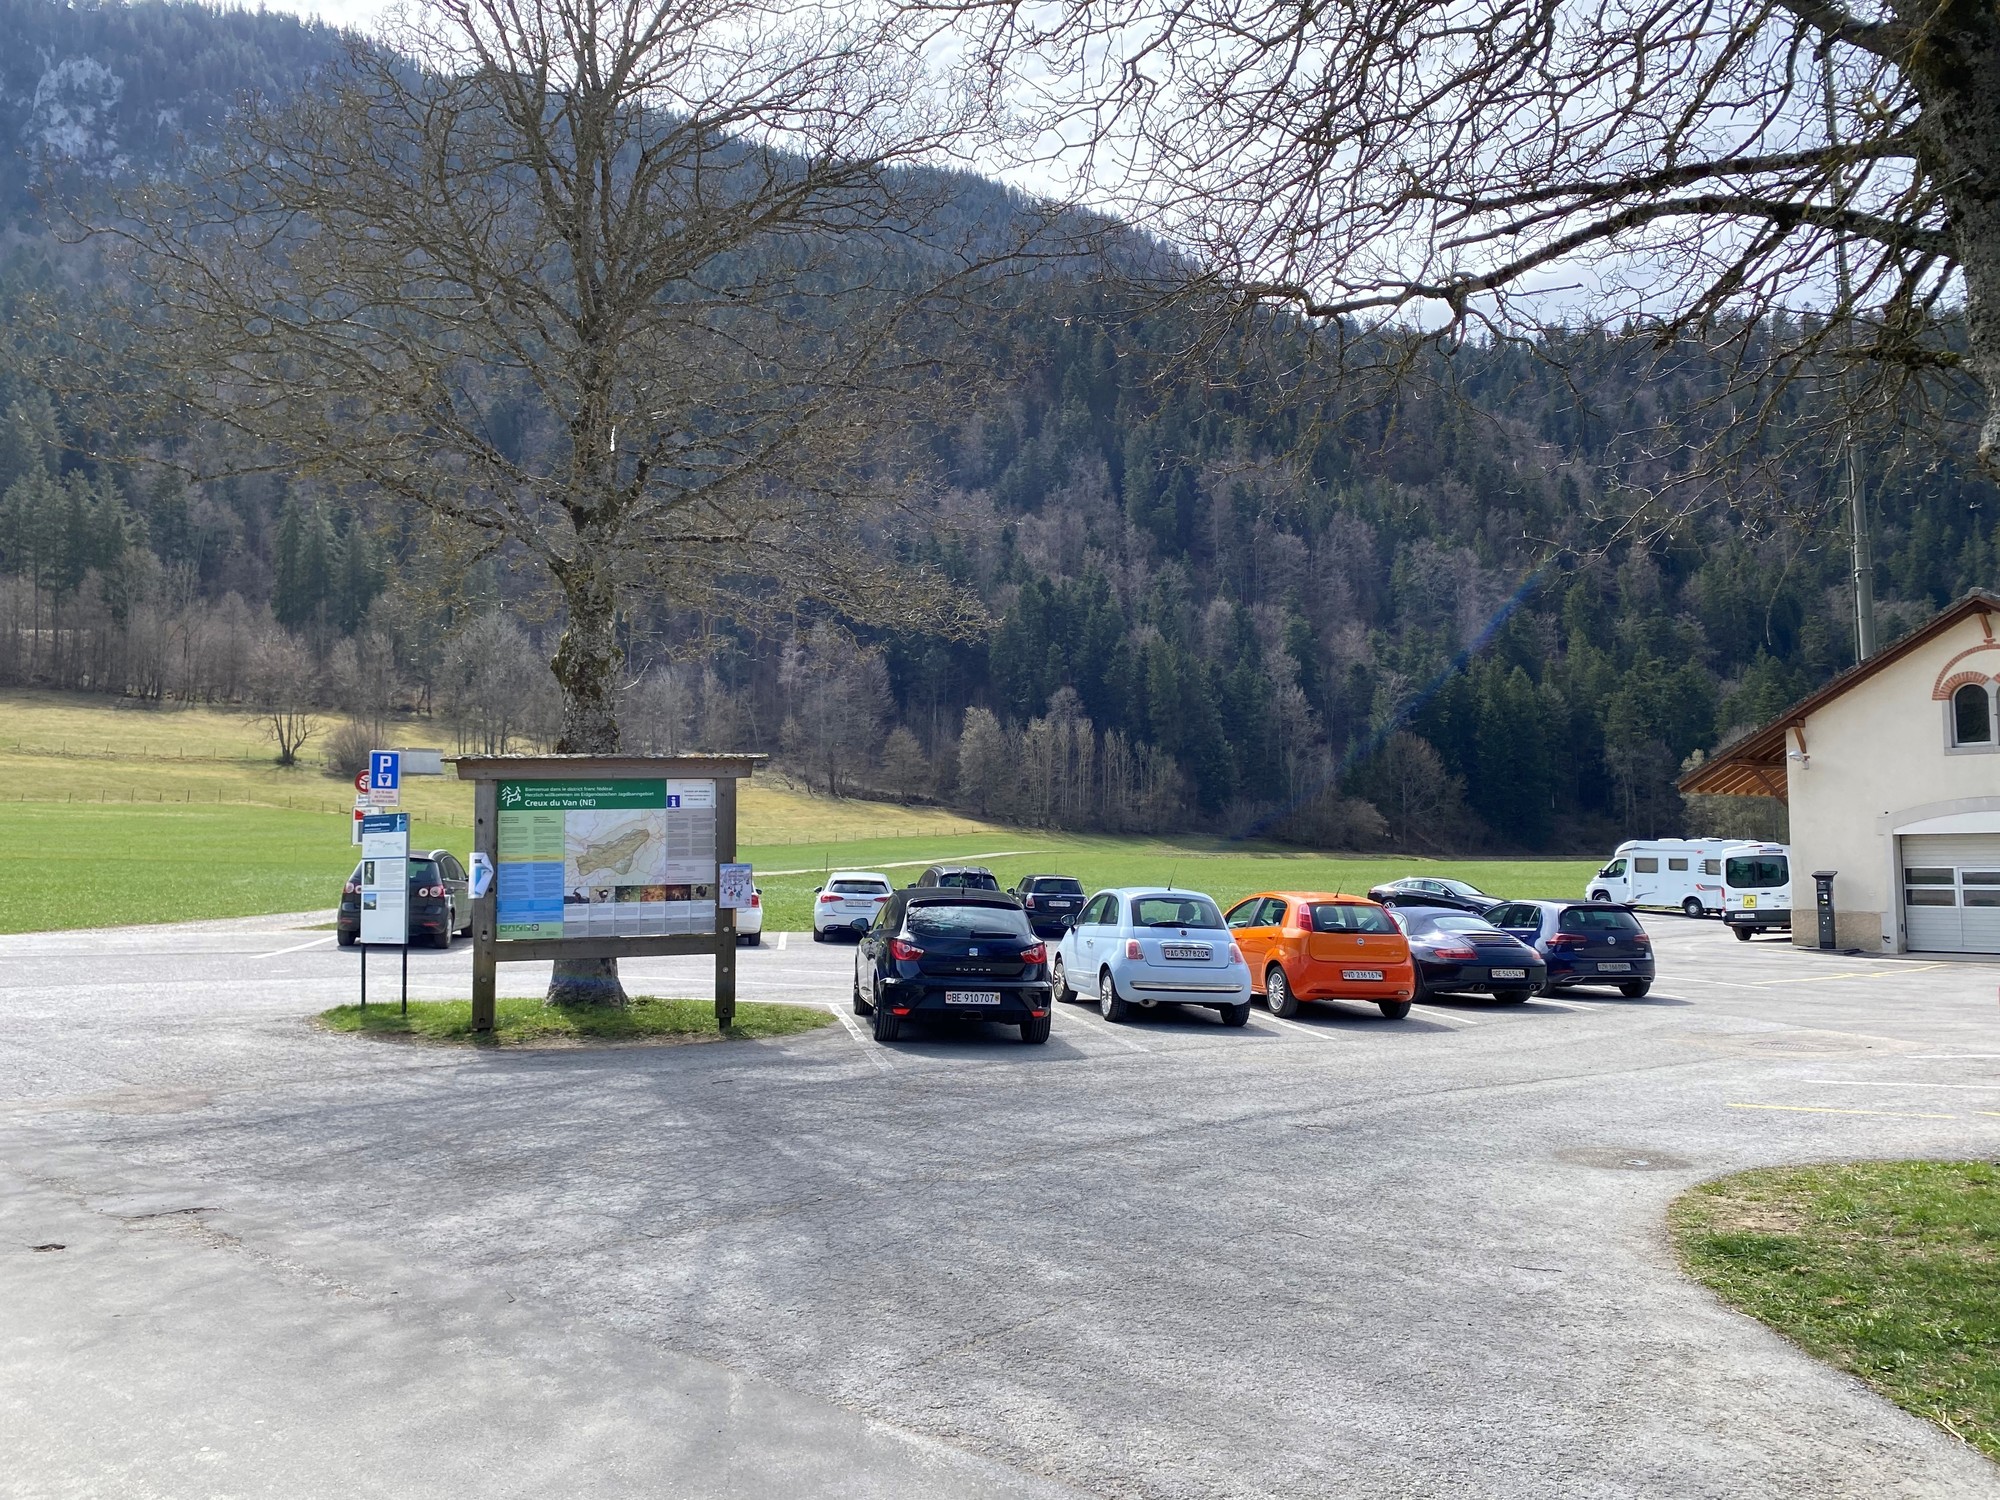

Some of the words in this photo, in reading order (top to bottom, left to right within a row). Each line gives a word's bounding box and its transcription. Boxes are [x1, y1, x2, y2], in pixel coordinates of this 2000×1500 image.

[380, 755, 392, 773] P
[579, 799, 596, 807] (NE)
[952, 993, 962, 1002] BE
[964, 993, 994, 1003] 910707
